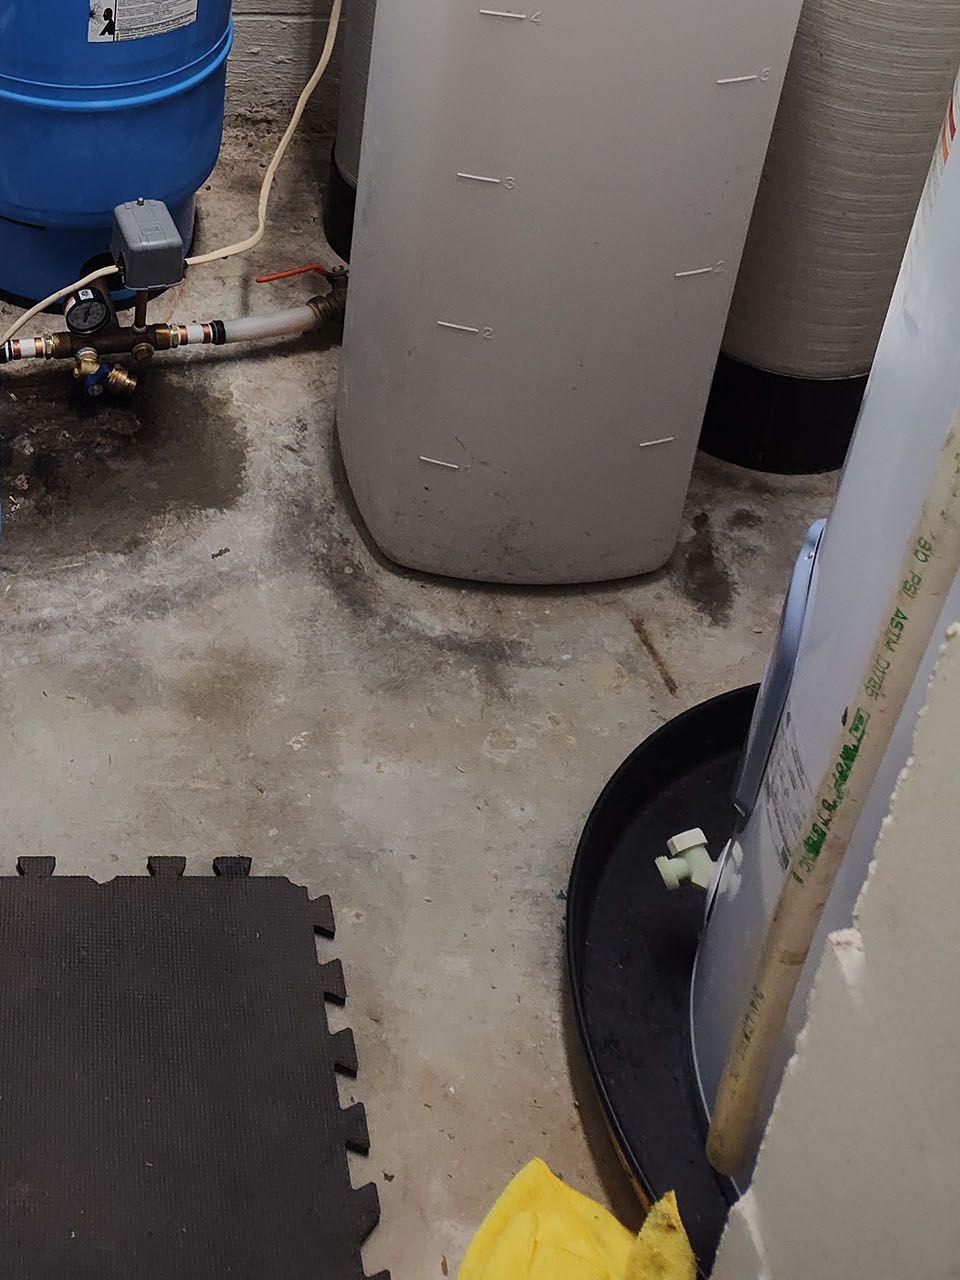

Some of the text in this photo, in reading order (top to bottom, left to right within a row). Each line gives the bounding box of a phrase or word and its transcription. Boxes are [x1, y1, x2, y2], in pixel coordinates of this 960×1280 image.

[760, 66, 770, 82] 3
[503, 175, 516, 190] 3
[713, 259, 725, 273] 2
[482, 325, 494, 340] 2
[901, 571, 922, 599] PSI
[884, 606, 909, 653] ASTM
